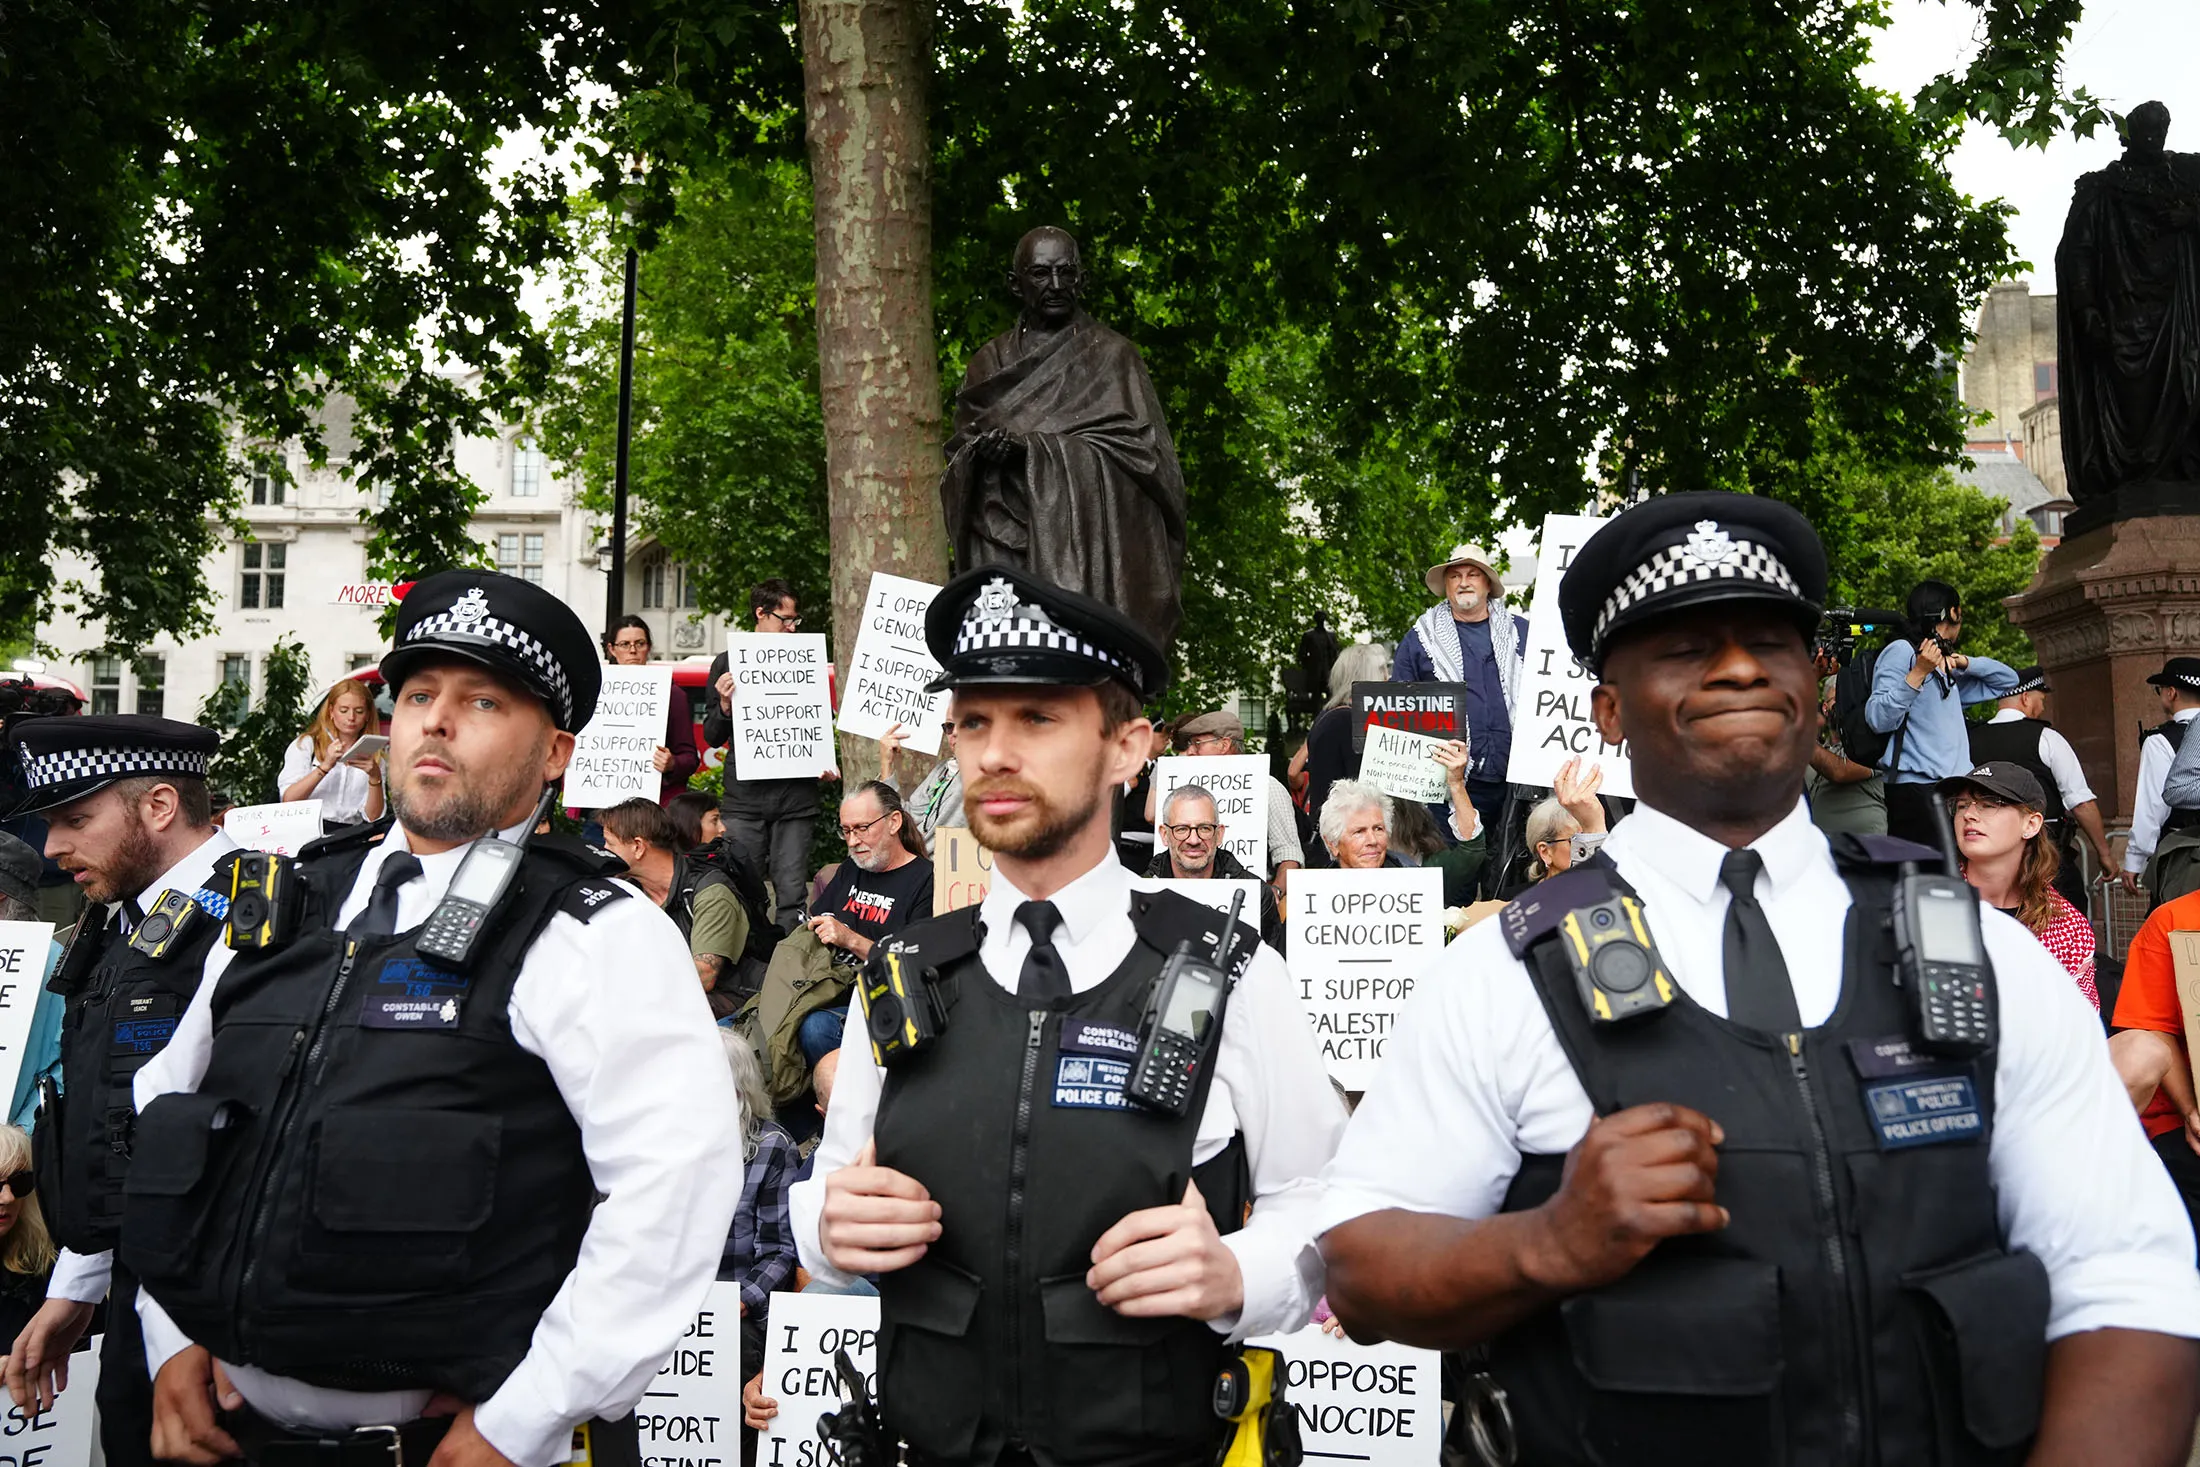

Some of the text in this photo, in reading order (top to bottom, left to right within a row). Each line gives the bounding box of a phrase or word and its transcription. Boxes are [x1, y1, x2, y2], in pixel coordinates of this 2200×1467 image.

[1556, 545, 1576, 571] I
[337, 585, 388, 604] MORE
[876, 592, 927, 617] I OPP
[873, 616, 927, 642] GENOC
[739, 649, 816, 664] I OPPOSE
[859, 653, 870, 670] I
[1537, 648, 1555, 676] I
[739, 670, 816, 685] GENOCIDE
[601, 681, 658, 696] OPPOSE
[858, 678, 938, 713] PALESTINE
[594, 701, 658, 717] ENOCIDE
[742, 704, 822, 721] I SUPPORT
[859, 699, 922, 728] ACTION
[1363, 696, 1453, 712] PALESTINE
[1363, 711, 1453, 732] ACTION
[578, 736, 657, 751] I SUPPORT
[745, 727, 823, 743] PALESTINE
[753, 744, 812, 759] ACTION
[1379, 733, 1435, 760] AHiMS
[575, 757, 652, 773] PALESTINE
[582, 774, 643, 790] ACTION
[1168, 774, 1253, 791] I OPPOSE
[1366, 769, 1425, 785] NON-VIOLENCE
[1429, 778, 1435, 788] to
[273, 807, 311, 818] POLICE
[1217, 798, 1253, 814] CIDE
[261, 824, 271, 836] I
[842, 896, 891, 925] ACTION
[1305, 893, 1424, 914] I OPPOSE
[1304, 924, 1424, 945] GENOCIDE
[405, 983, 433, 998] TSG
[1300, 978, 1416, 1000] I SUPPOR
[382, 1002, 441, 1012] CONSTABLE
[394, 1012, 424, 1021] OWEN
[137, 1029, 167, 1037] POLICE
[1083, 1026, 1141, 1045] CONSTABL
[1077, 1033, 1137, 1053] MCCLELLA
[1322, 1038, 1388, 1060] ACTI
[1097, 1064, 1129, 1075] METROP
[1056, 1088, 1103, 1104] POLICE
[1917, 1092, 1962, 1111] POLICE
[1882, 1119, 1932, 1139] POLICE
[781, 1325, 876, 1356] I OPP
[1287, 1360, 1417, 1395] OPPOSE
[636, 1415, 720, 1443] PPORT
[1295, 1402, 1416, 1437] NOCIDE
[769, 1437, 786, 1467] I
